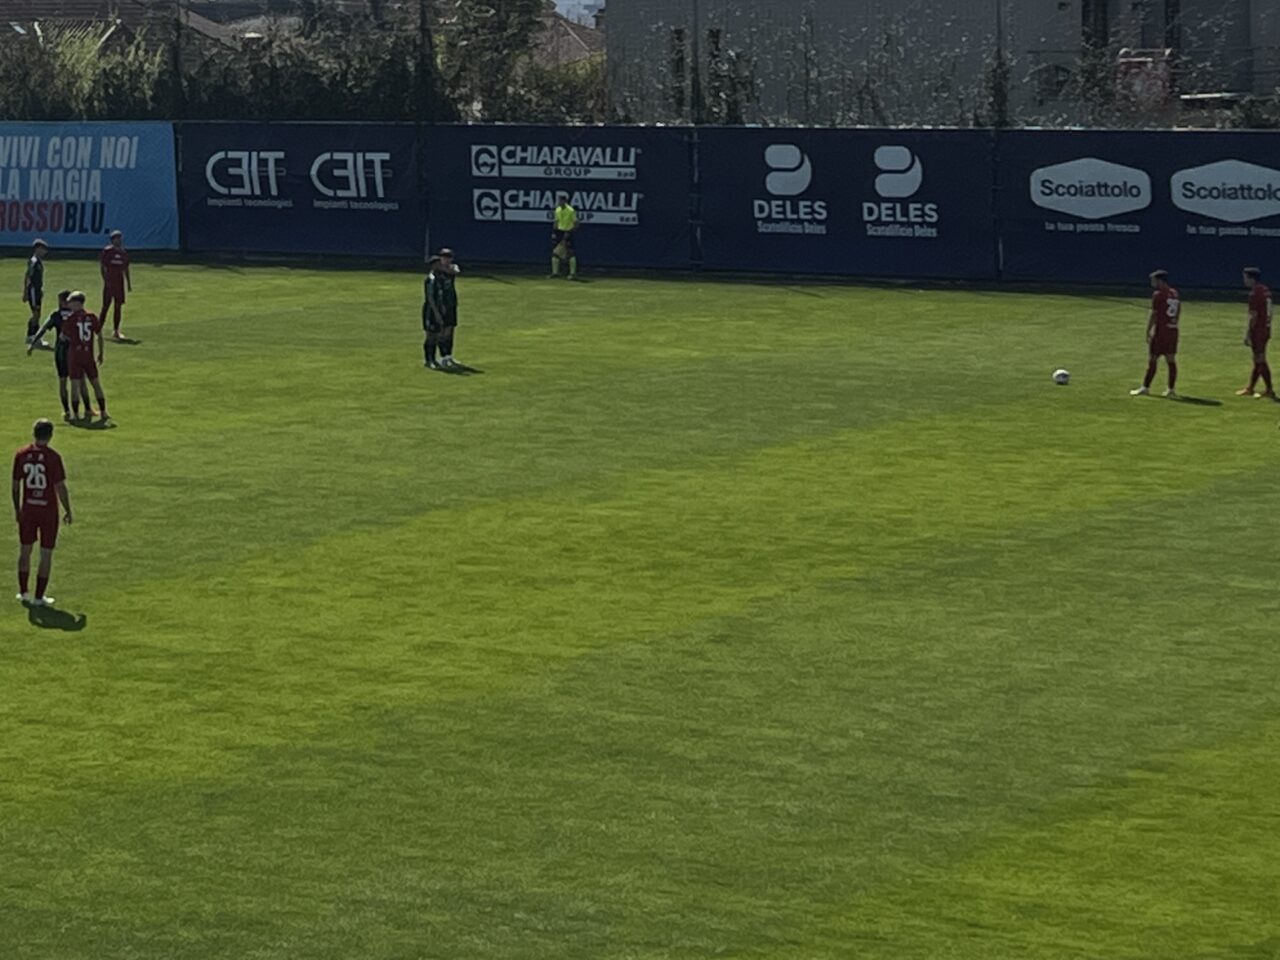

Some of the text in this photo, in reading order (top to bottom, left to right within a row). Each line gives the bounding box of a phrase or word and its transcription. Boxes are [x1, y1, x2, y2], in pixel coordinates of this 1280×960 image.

[47, 136, 92, 168] CON
[100, 136, 139, 169] NOI
[500, 145, 636, 166] CHIARAVALLI
[543, 166, 592, 177] GROUP
[29, 169, 102, 201] MAGIA
[1040, 179, 1141, 198] Scoiattolo
[546, 212, 594, 222] GUP
[753, 200, 828, 220] DELES
[862, 202, 939, 223] DELES
[76, 321, 92, 342] 15
[23, 463, 47, 490] 26
